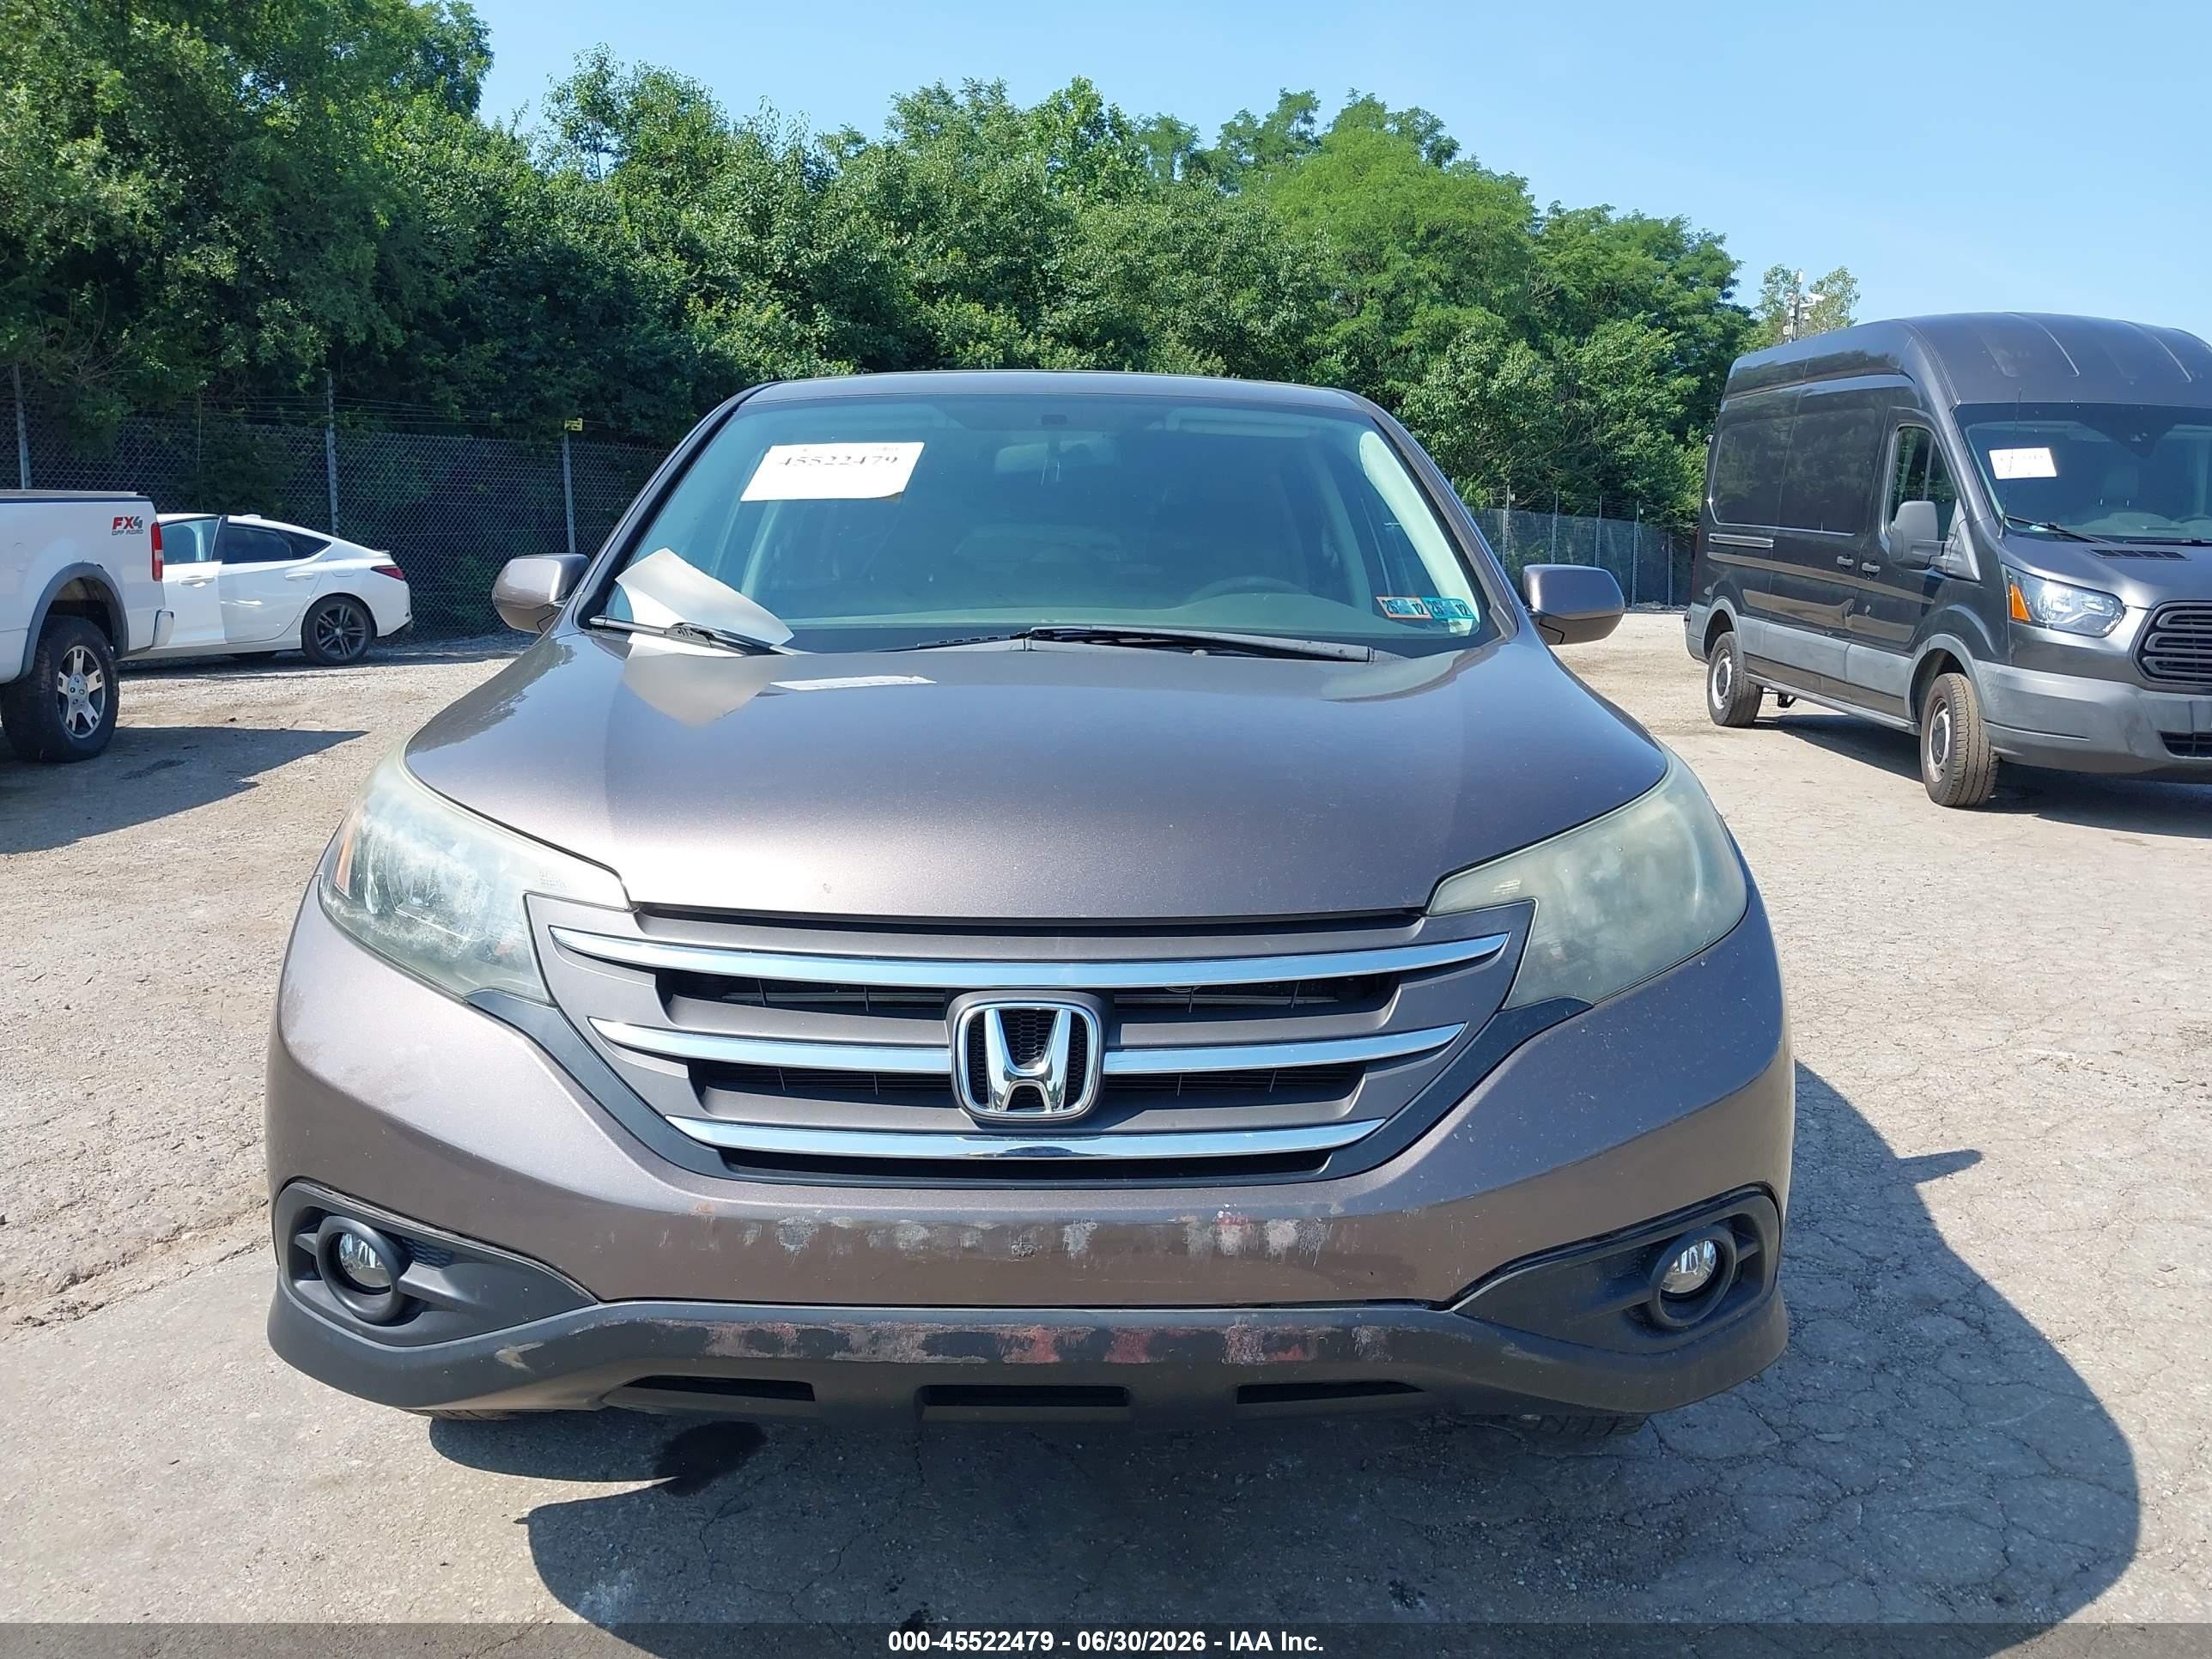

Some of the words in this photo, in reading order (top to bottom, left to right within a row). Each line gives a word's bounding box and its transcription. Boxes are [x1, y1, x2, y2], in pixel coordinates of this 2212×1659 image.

[112, 515, 143, 530] FX4
[1412, 603, 1429, 616] 12
[1455, 603, 1471, 617] 12
